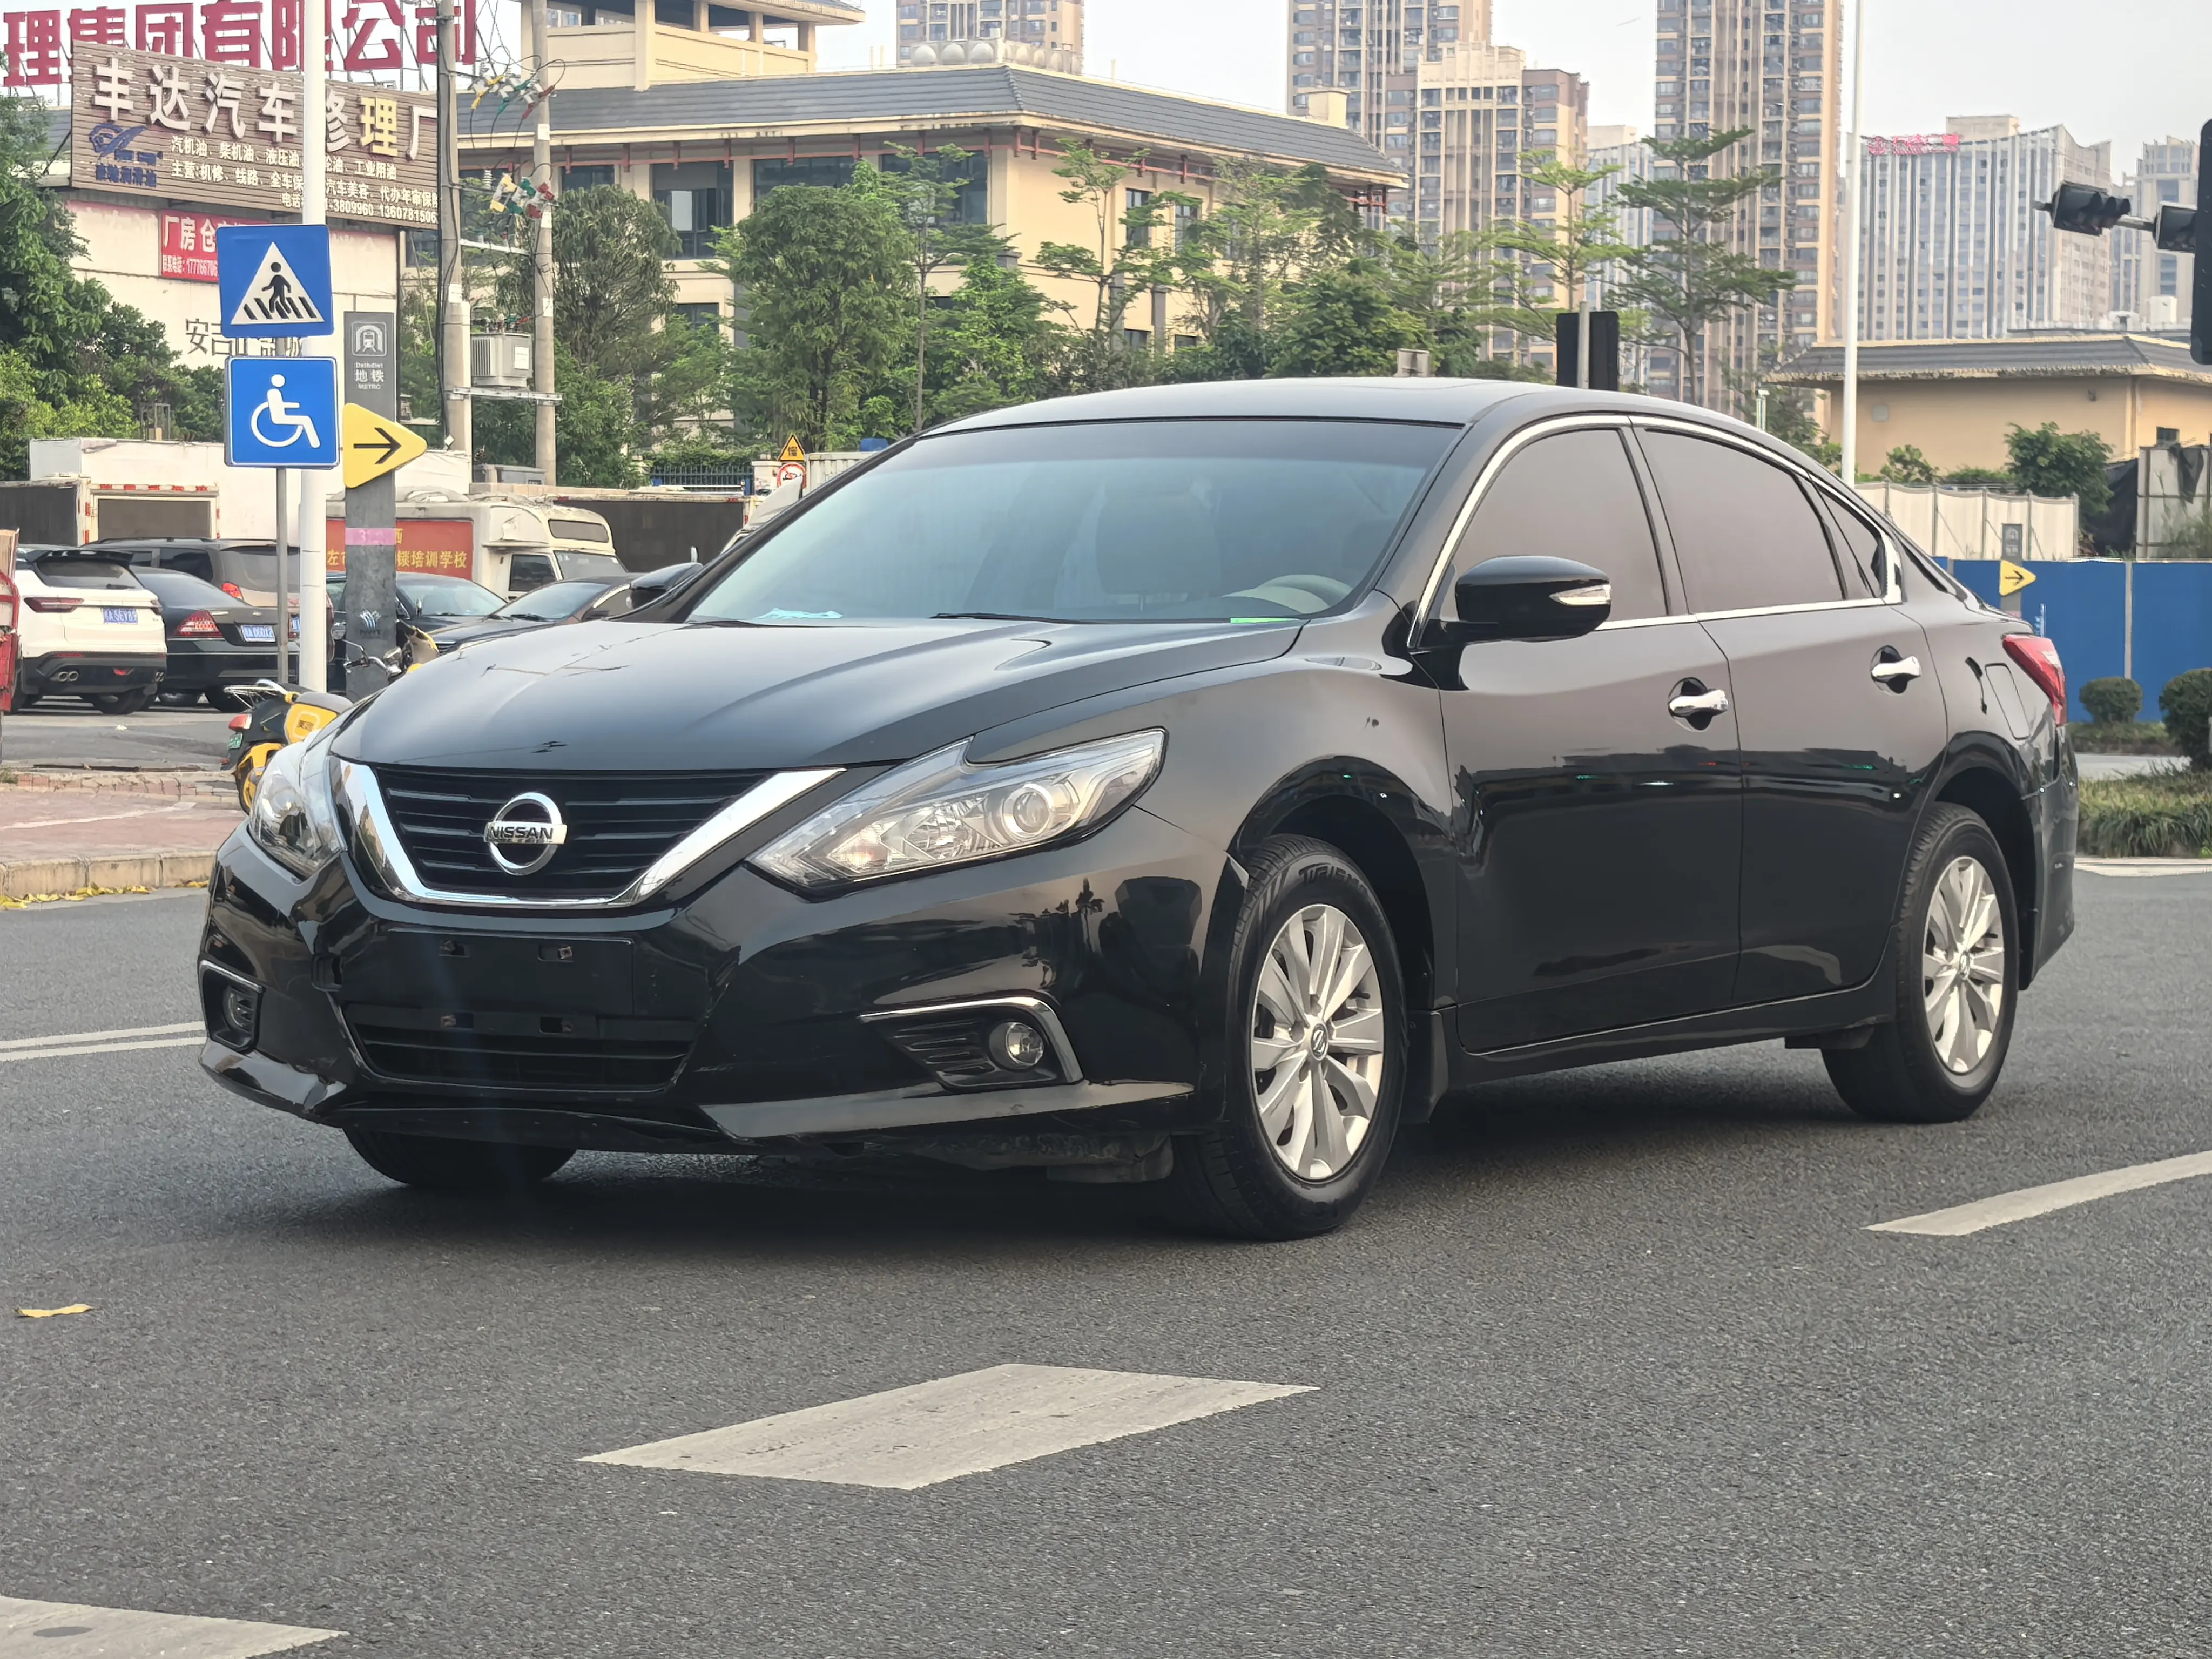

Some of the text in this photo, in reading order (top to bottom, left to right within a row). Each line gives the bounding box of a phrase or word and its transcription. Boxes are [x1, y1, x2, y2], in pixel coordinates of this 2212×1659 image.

[92, 57, 437, 160] 丰达汽车修理厂
[379, 204, 438, 224] 1360781506
[355, 369, 384, 383] 地铁
[489, 826, 554, 840] NISSAN
